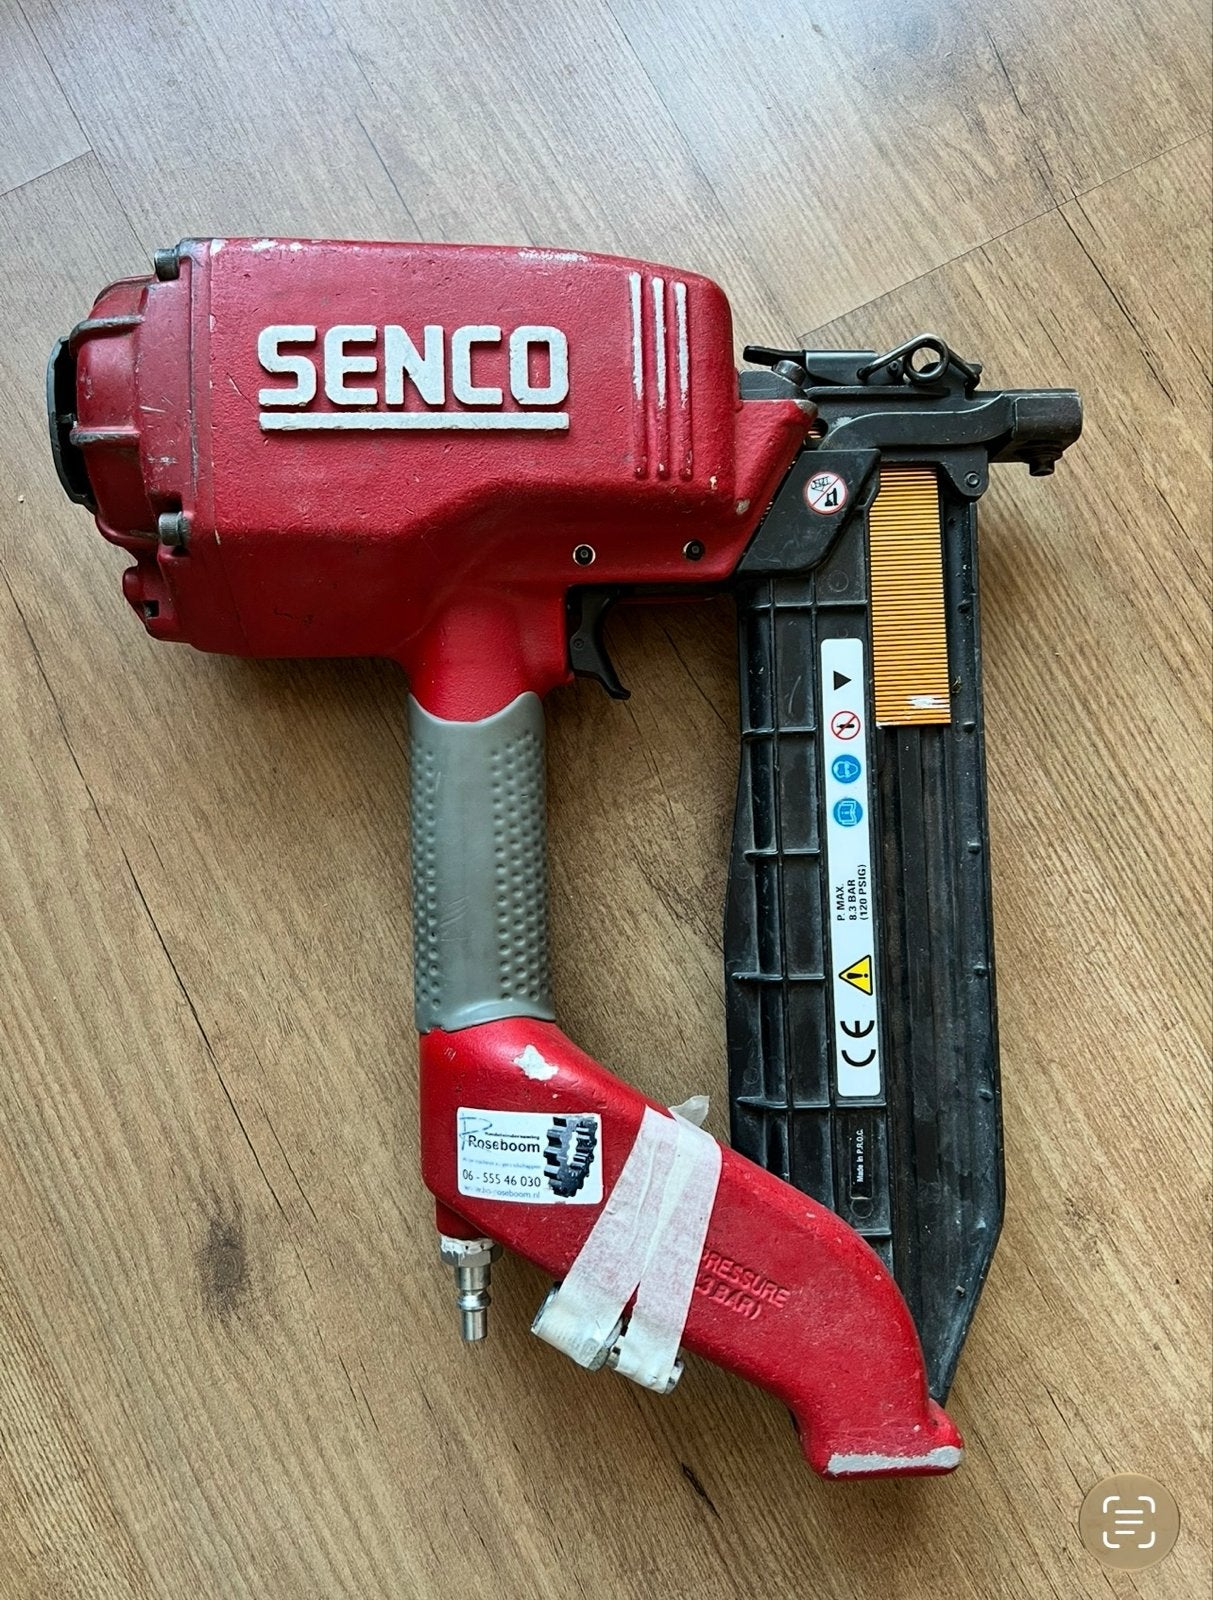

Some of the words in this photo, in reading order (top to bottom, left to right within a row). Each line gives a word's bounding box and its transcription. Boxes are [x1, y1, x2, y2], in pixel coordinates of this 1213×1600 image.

[257, 325, 570, 406] SENCO
[847, 879, 856, 902] BAR
[857, 864, 867, 895] PSIG)
[835, 883, 845, 910] MAX.
[836, 913, 845, 921] P.
[848, 905, 857, 920] 8.3
[859, 898, 869, 920] (120
[468, 1134, 540, 1153] Roseboom
[462, 1169, 474, 1181] 06
[483, 1172, 501, 1184] 555
[504, 1175, 517, 1186] 46
[520, 1176, 541, 1187] 030
[708, 1281, 762, 1320] BAR)
